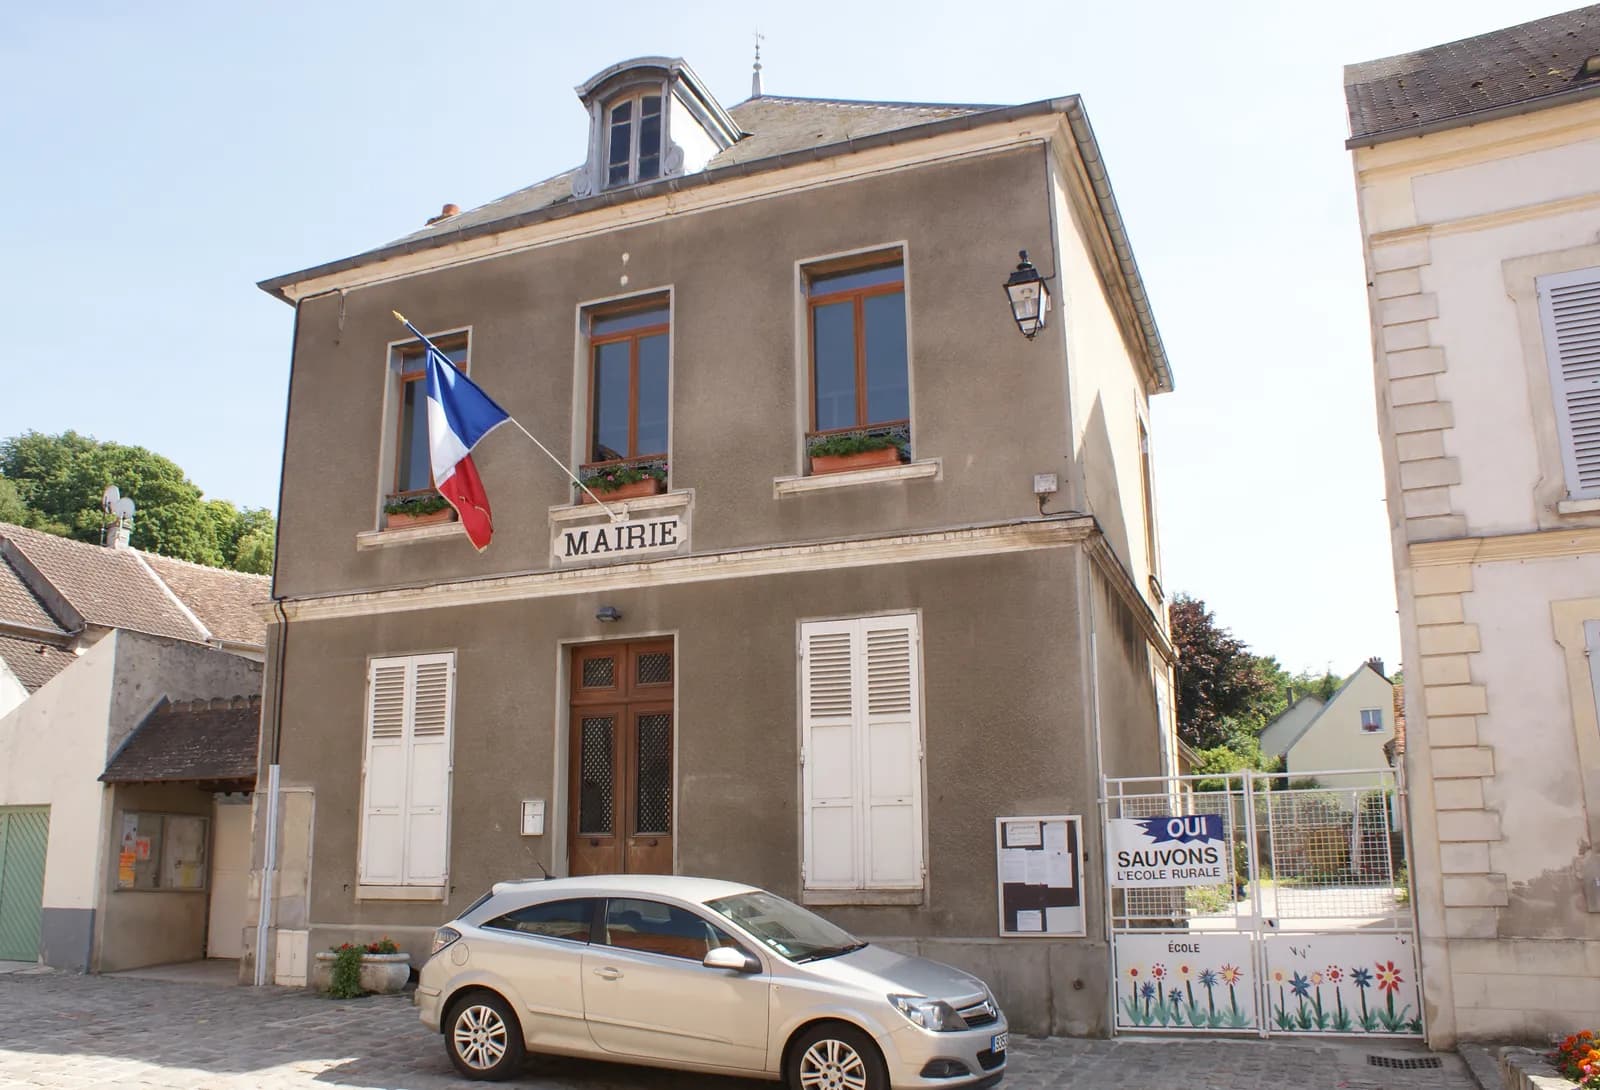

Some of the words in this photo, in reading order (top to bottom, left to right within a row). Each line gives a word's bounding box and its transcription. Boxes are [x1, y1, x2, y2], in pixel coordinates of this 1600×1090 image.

[564, 520, 677, 556] MAIRIE
[1166, 816, 1207, 837] OUI
[1117, 847, 1218, 868] SAUVONS
[1117, 869, 1167, 881] L'ECOLE
[1172, 867, 1220, 879] RURALE
[1168, 940, 1201, 953] ÉCOLE
